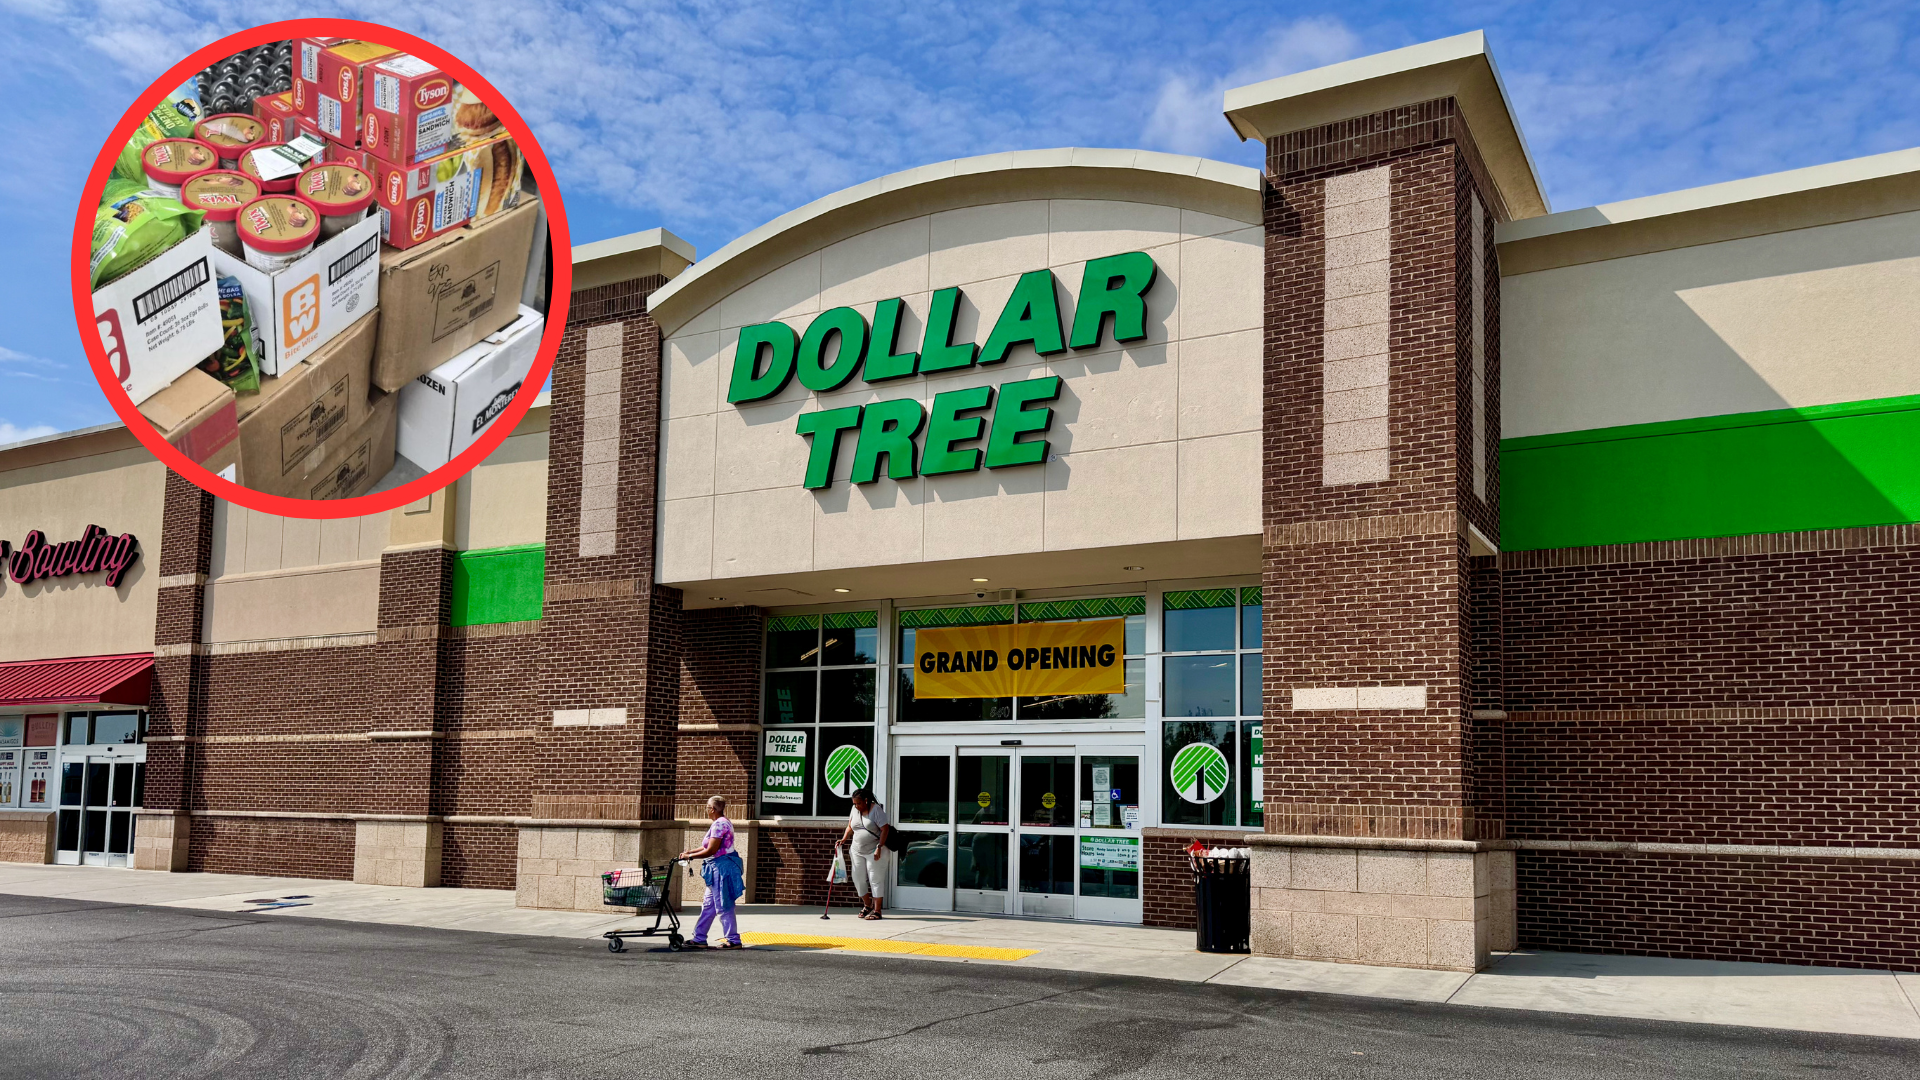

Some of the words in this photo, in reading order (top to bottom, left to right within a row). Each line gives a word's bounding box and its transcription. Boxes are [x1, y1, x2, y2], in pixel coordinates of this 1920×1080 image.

[342, 71, 351, 99] Tyson
[419, 86, 447, 105] Tyson
[153, 109, 177, 130] BLEND
[158, 104, 176, 118] STIR
[174, 115, 187, 127] FRY
[418, 119, 451, 135] SANDWICH
[367, 116, 376, 144] Tyson
[391, 175, 401, 203] Tyson
[446, 180, 455, 225] SANDWICH
[413, 200, 426, 237] Tyson
[146, 334, 159, 345] Case
[727, 251, 1157, 404] DOLLAR
[148, 343, 158, 352] Net
[285, 345, 301, 360] Bite
[301, 333, 318, 348] Wise
[416, 373, 446, 396] OZEN
[796, 375, 1064, 489] TREE
[9, 524, 138, 588] Bowling
[919, 649, 999, 674] GRAND
[1007, 644, 1116, 671] OPENING
[777, 688, 795, 723] REE
[768, 735, 804, 744] DOLLAR
[774, 744, 797, 753] TREE
[769, 761, 800, 773] NOW
[765, 775, 802, 787] OPEN!
